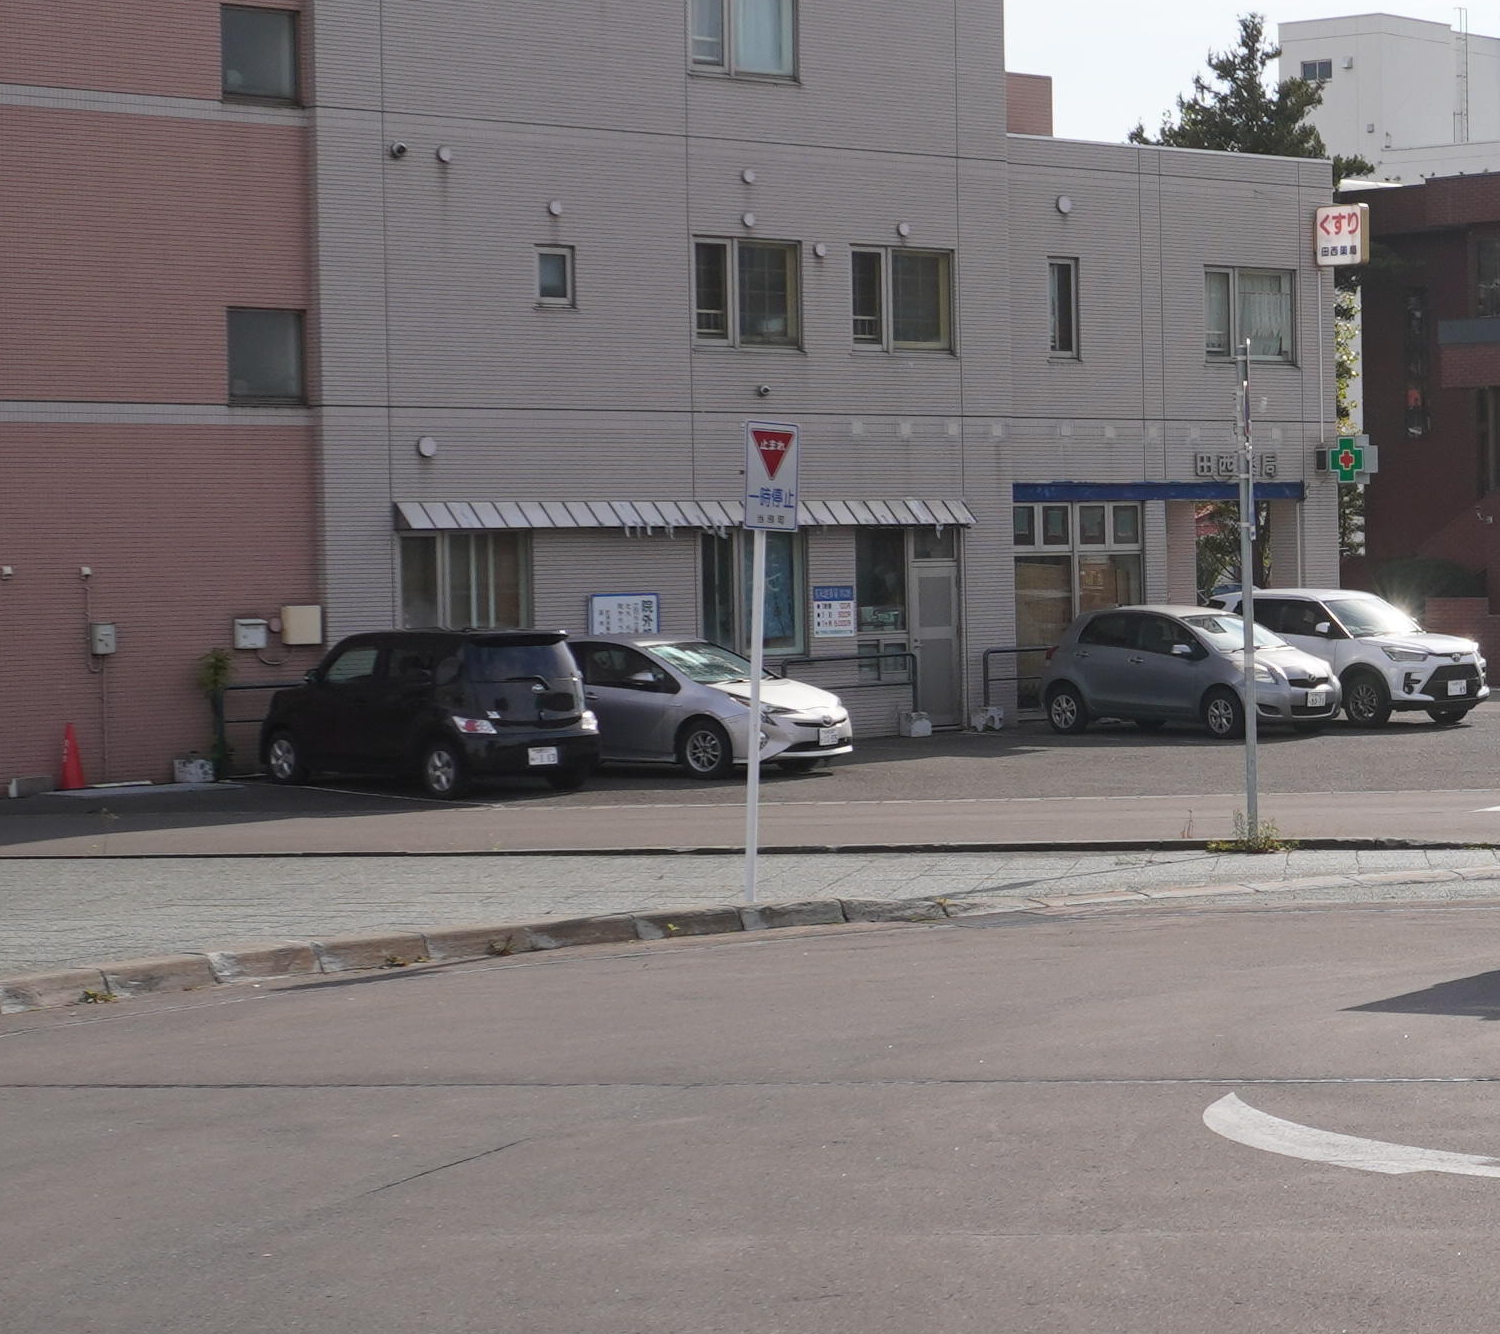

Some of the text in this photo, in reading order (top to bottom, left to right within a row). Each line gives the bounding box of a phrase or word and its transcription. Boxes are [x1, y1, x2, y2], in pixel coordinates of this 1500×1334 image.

[1319, 211, 1359, 236] くすり
[759, 439, 788, 451] 止まれ
[747, 488, 795, 508] 一時停止
